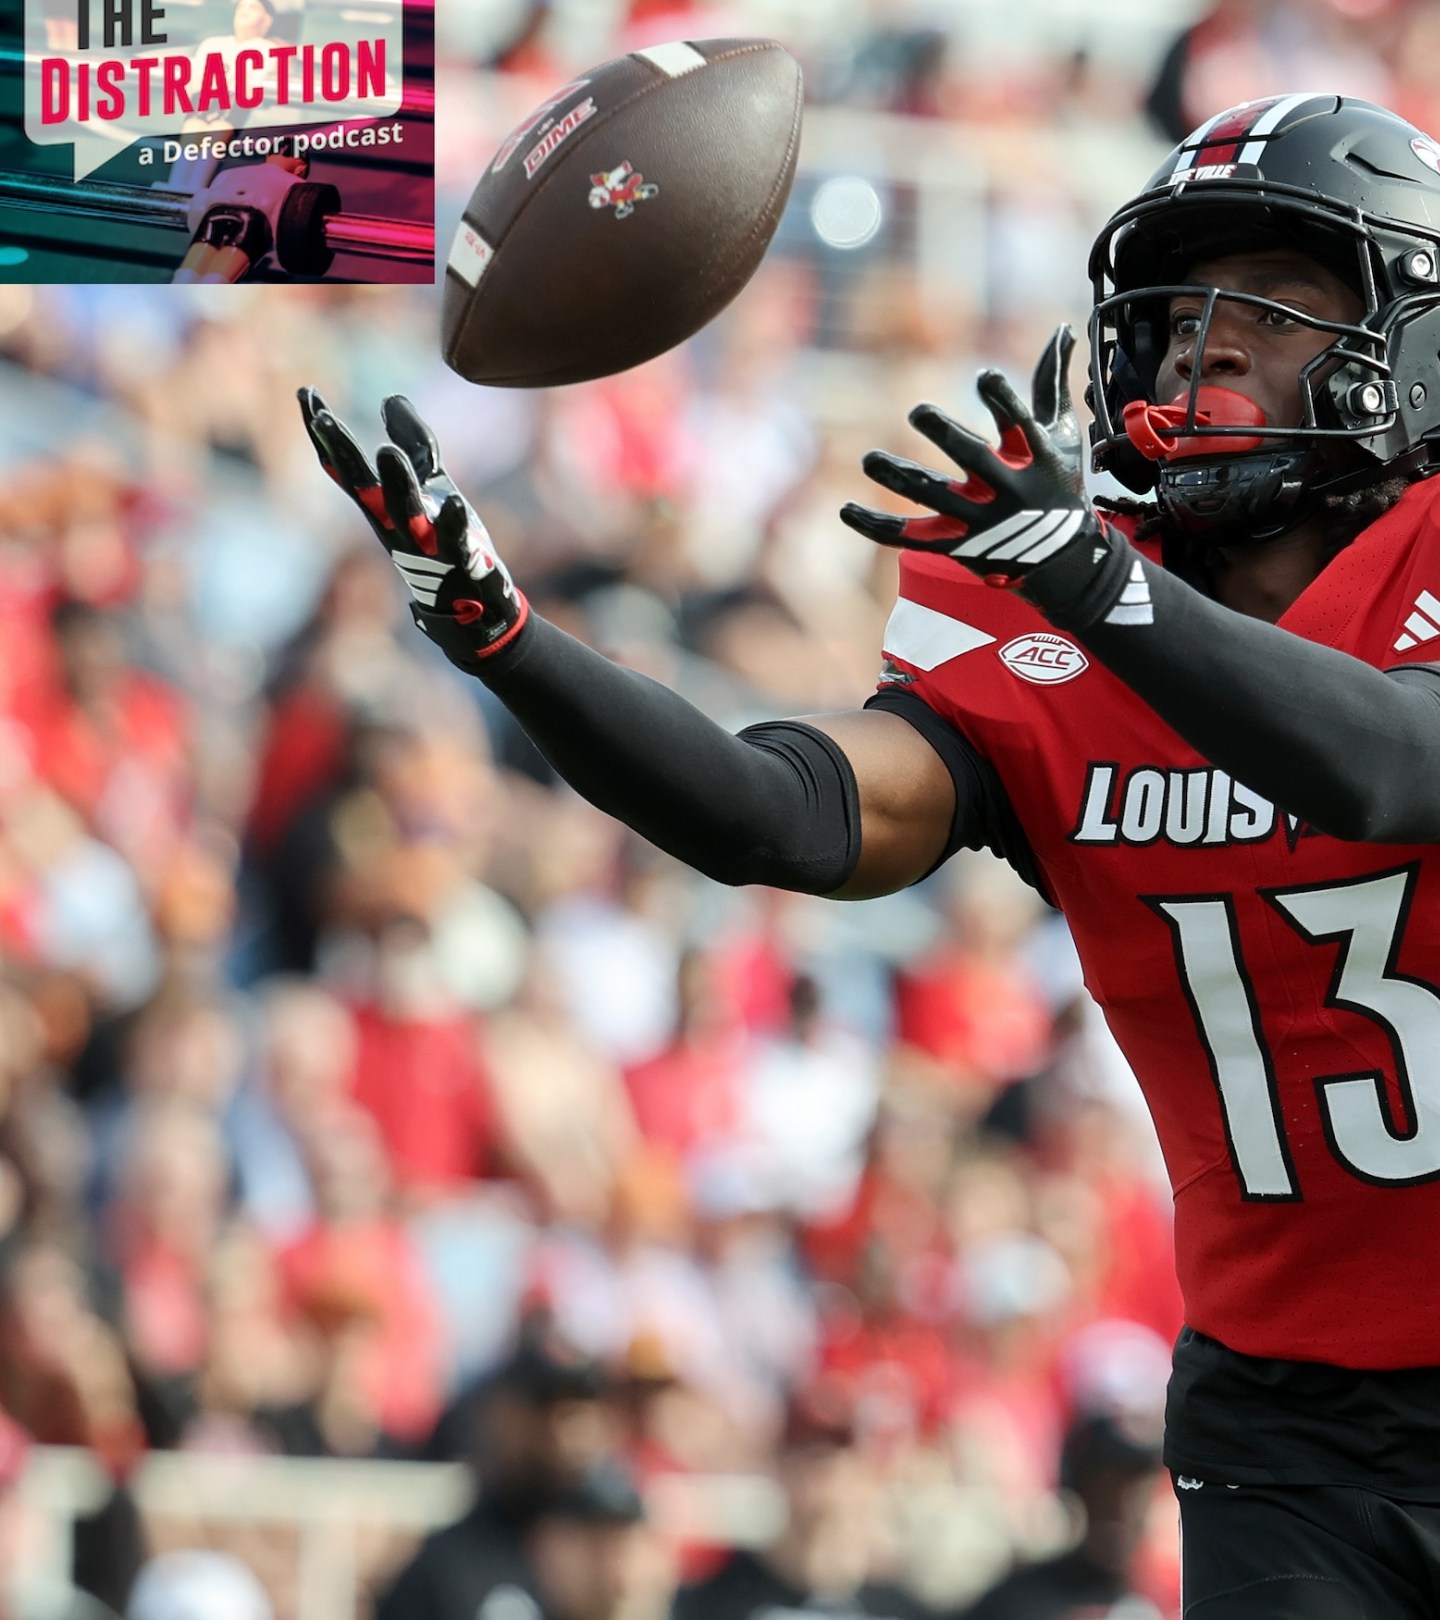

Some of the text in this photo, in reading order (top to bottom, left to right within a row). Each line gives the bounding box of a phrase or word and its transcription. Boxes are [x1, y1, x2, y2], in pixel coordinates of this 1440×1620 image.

[523, 96, 598, 180] DIME
[1013, 646, 1077, 666] ACC
[1070, 763, 1300, 848] LOUIS
